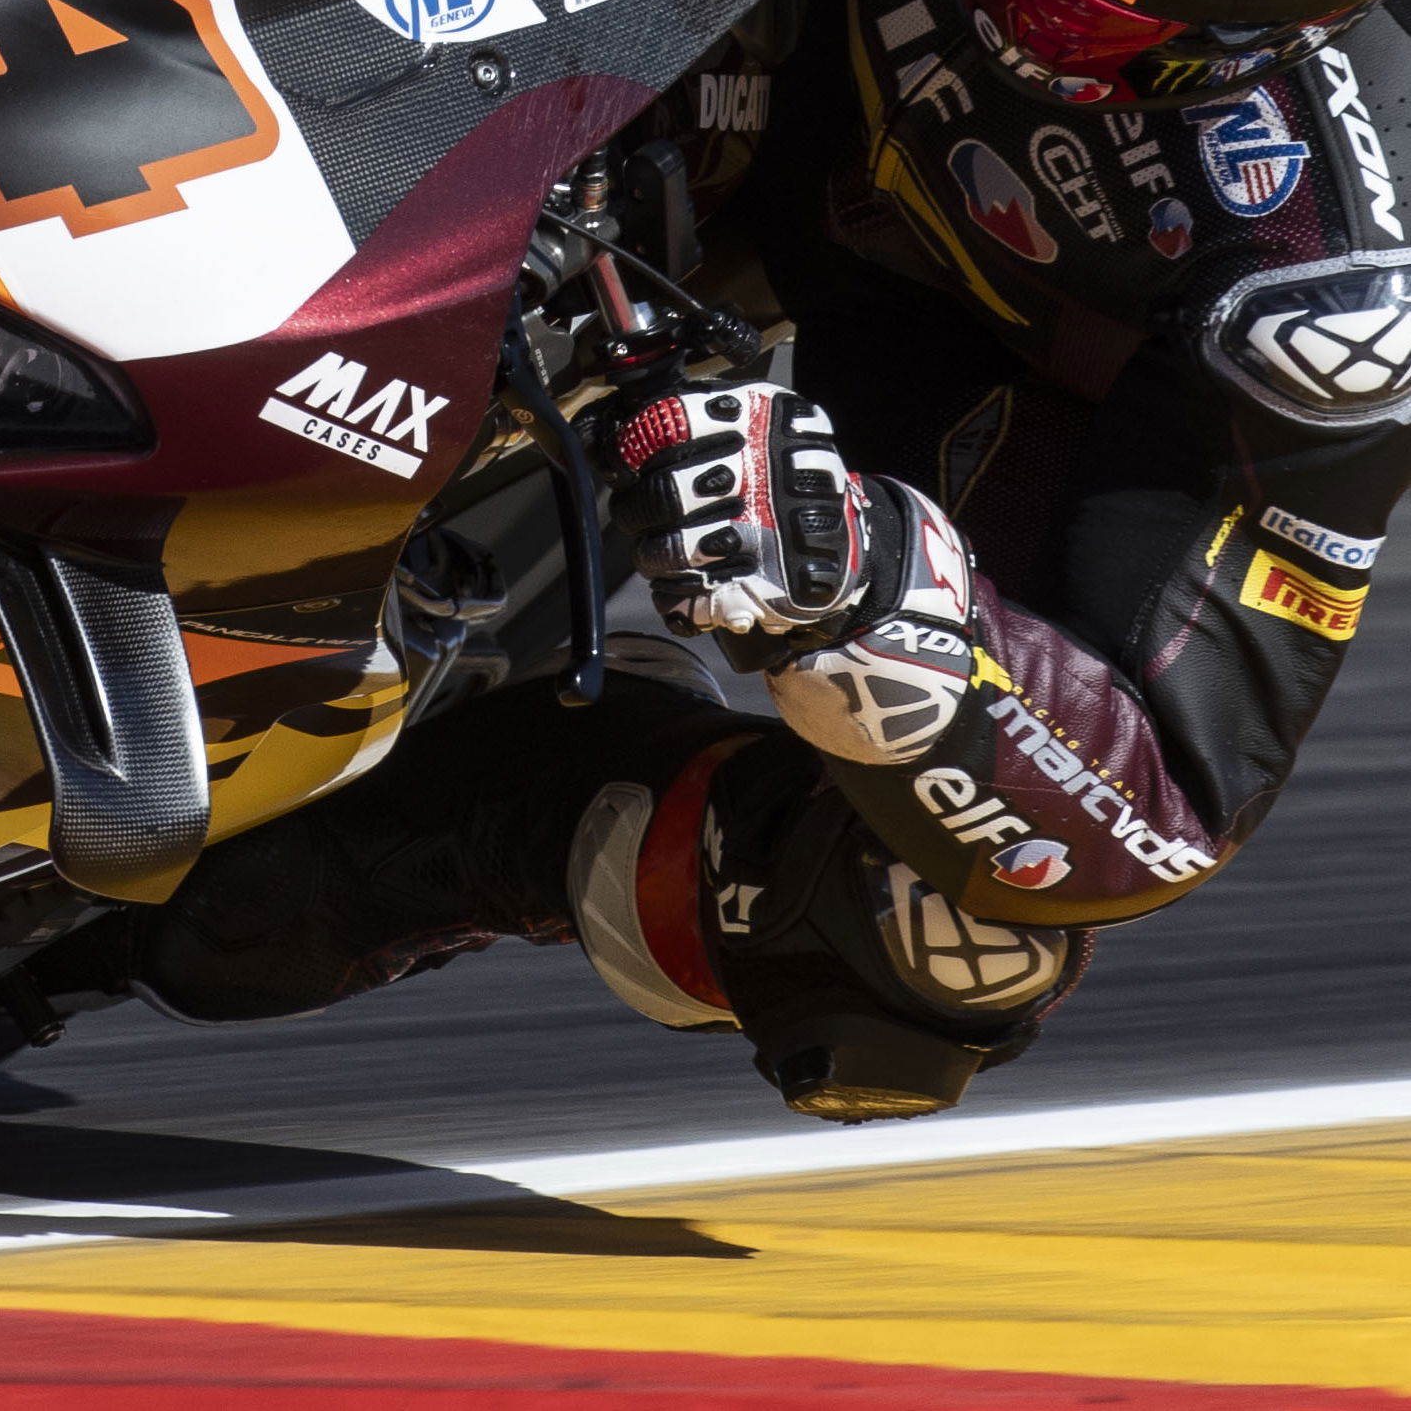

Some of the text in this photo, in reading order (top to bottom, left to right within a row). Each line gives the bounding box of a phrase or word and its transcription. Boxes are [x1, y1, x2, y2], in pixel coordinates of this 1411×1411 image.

[430, 6, 476, 28] GENEVA
[275, 350, 450, 453] MAX
[302, 418, 383, 463] CASES
[914, 767, 1032, 845] elf
